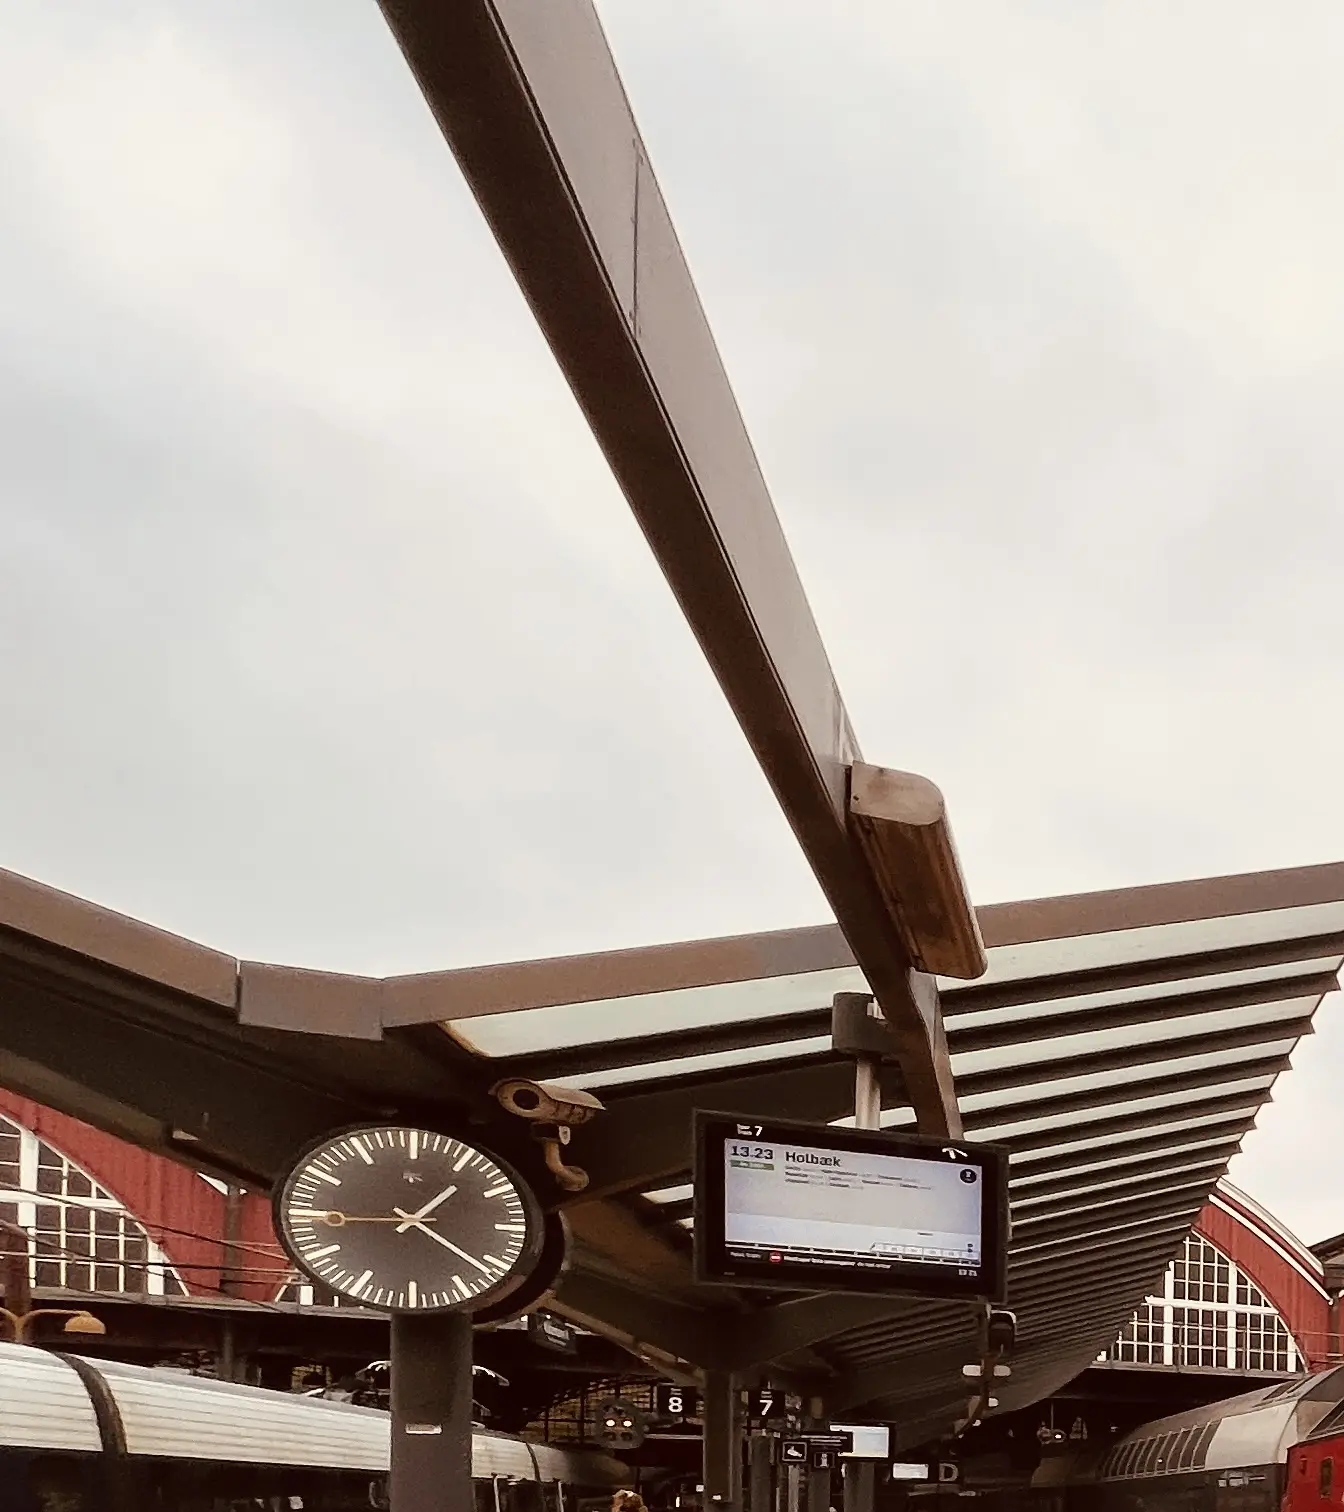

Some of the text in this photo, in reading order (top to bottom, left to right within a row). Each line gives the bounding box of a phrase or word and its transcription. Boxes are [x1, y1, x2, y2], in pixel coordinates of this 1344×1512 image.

[754, 1126, 763, 1136] 7
[785, 1151, 841, 1167] Holbæk
[668, 1396, 683, 1413] 8
[759, 1399, 773, 1416] 7
[938, 1463, 959, 1482] D
